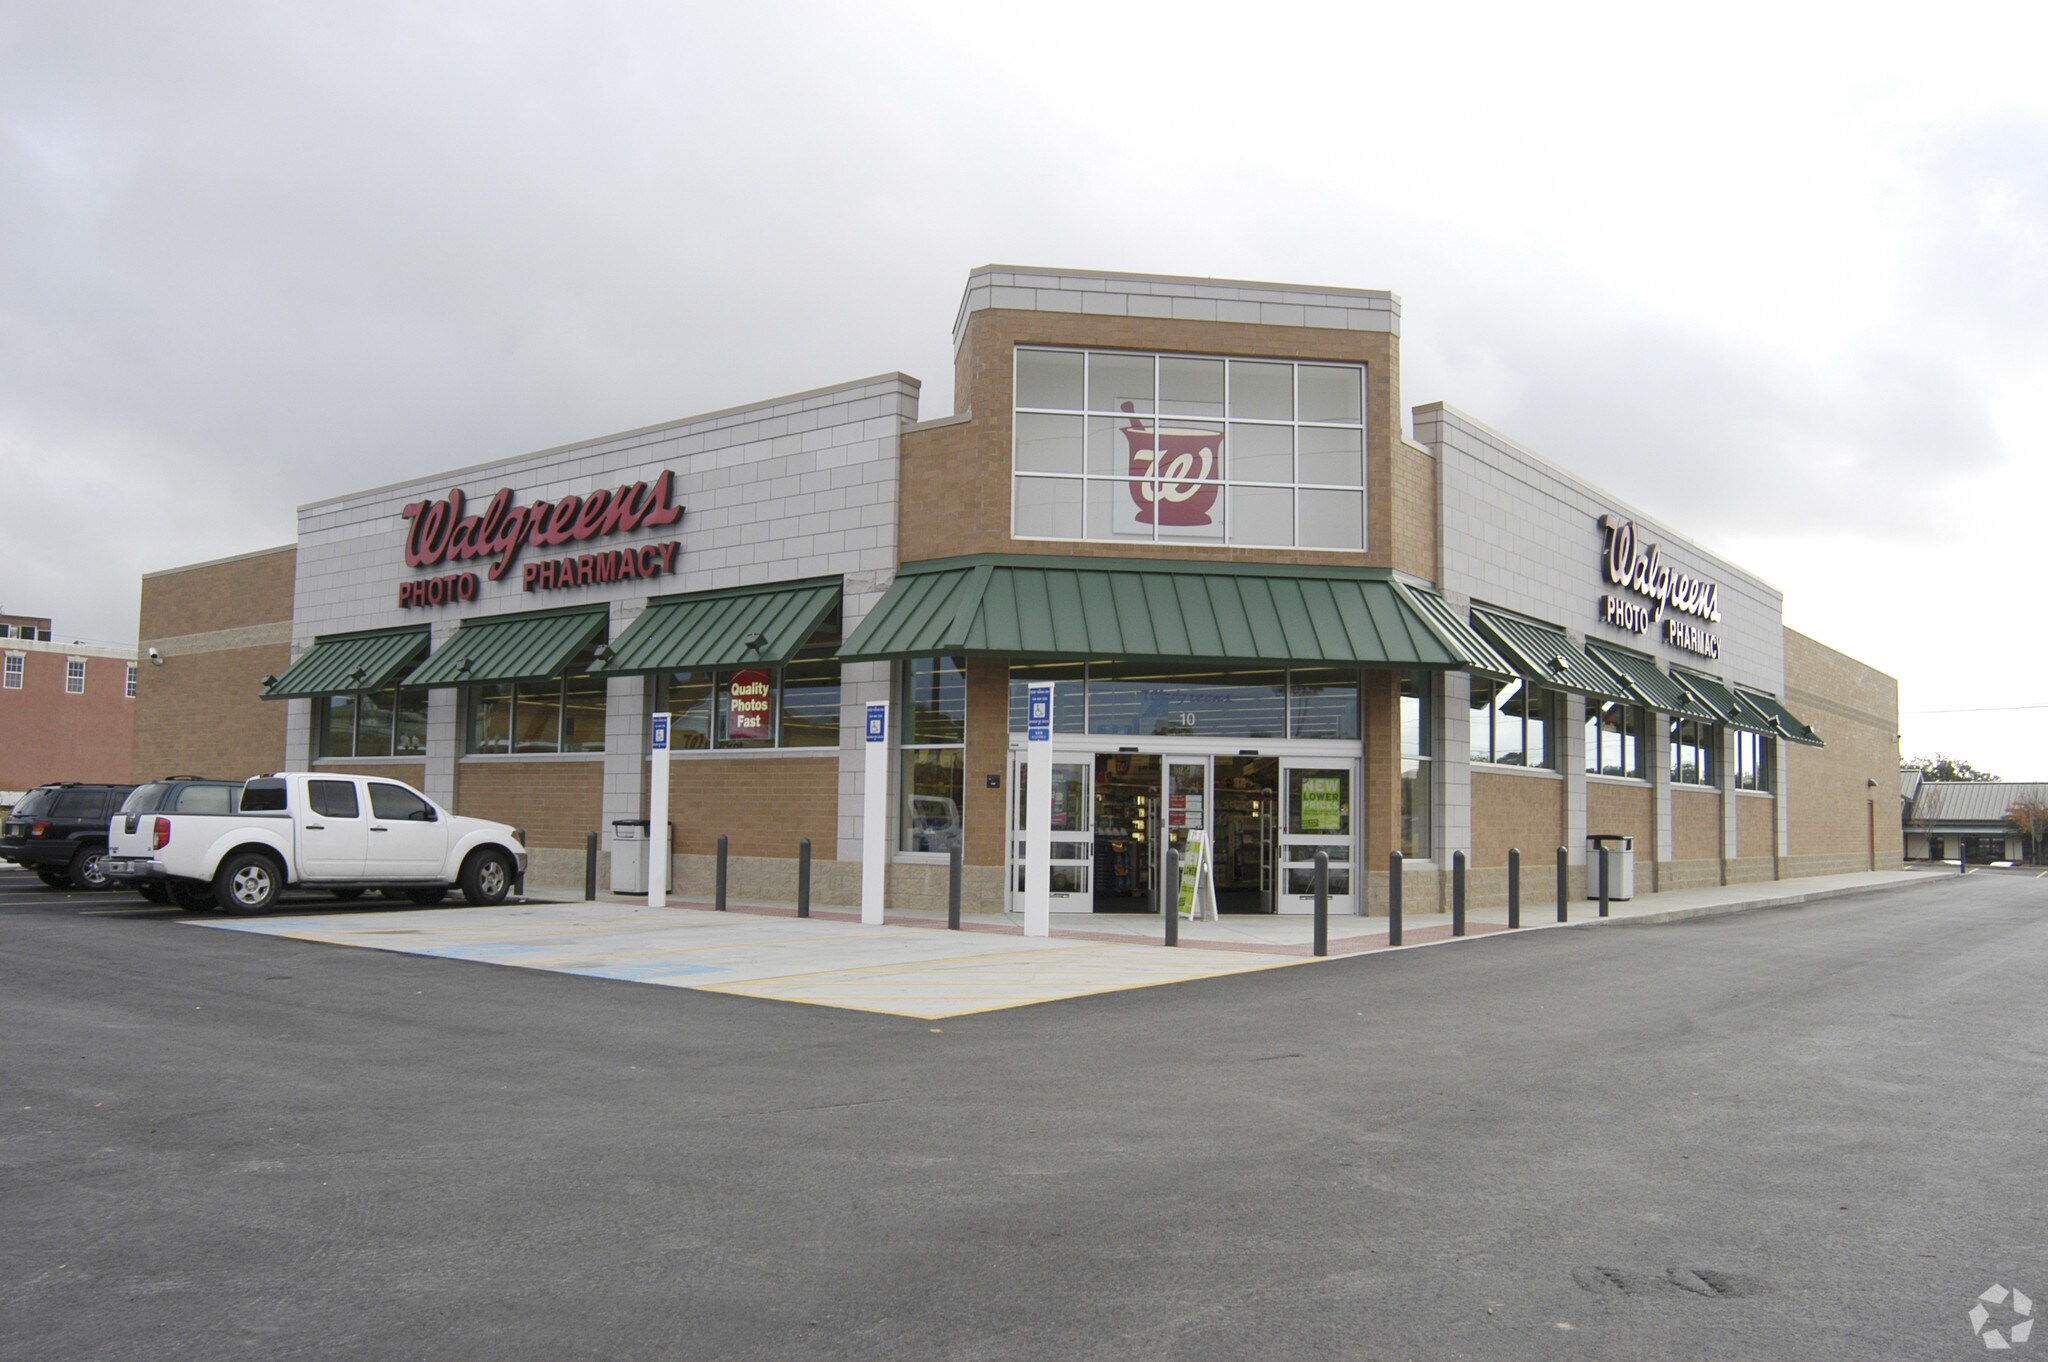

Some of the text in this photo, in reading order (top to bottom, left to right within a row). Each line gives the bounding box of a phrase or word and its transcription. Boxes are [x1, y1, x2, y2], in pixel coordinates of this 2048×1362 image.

[402, 470, 686, 581] Walgreens
[399, 541, 681, 608] PHOTO PHARMACY
[1601, 514, 1721, 623] Walgreens
[1604, 595, 1722, 660] PHOTO PHARMACY
[731, 682, 769, 697] Quality
[731, 699, 768, 711] Photos
[737, 715, 761, 728] Fast
[1179, 713, 1196, 726] 10
[1303, 779, 1339, 792] NEW
[1303, 793, 1339, 801] LOWER
[1303, 801, 1340, 810] PRICES
